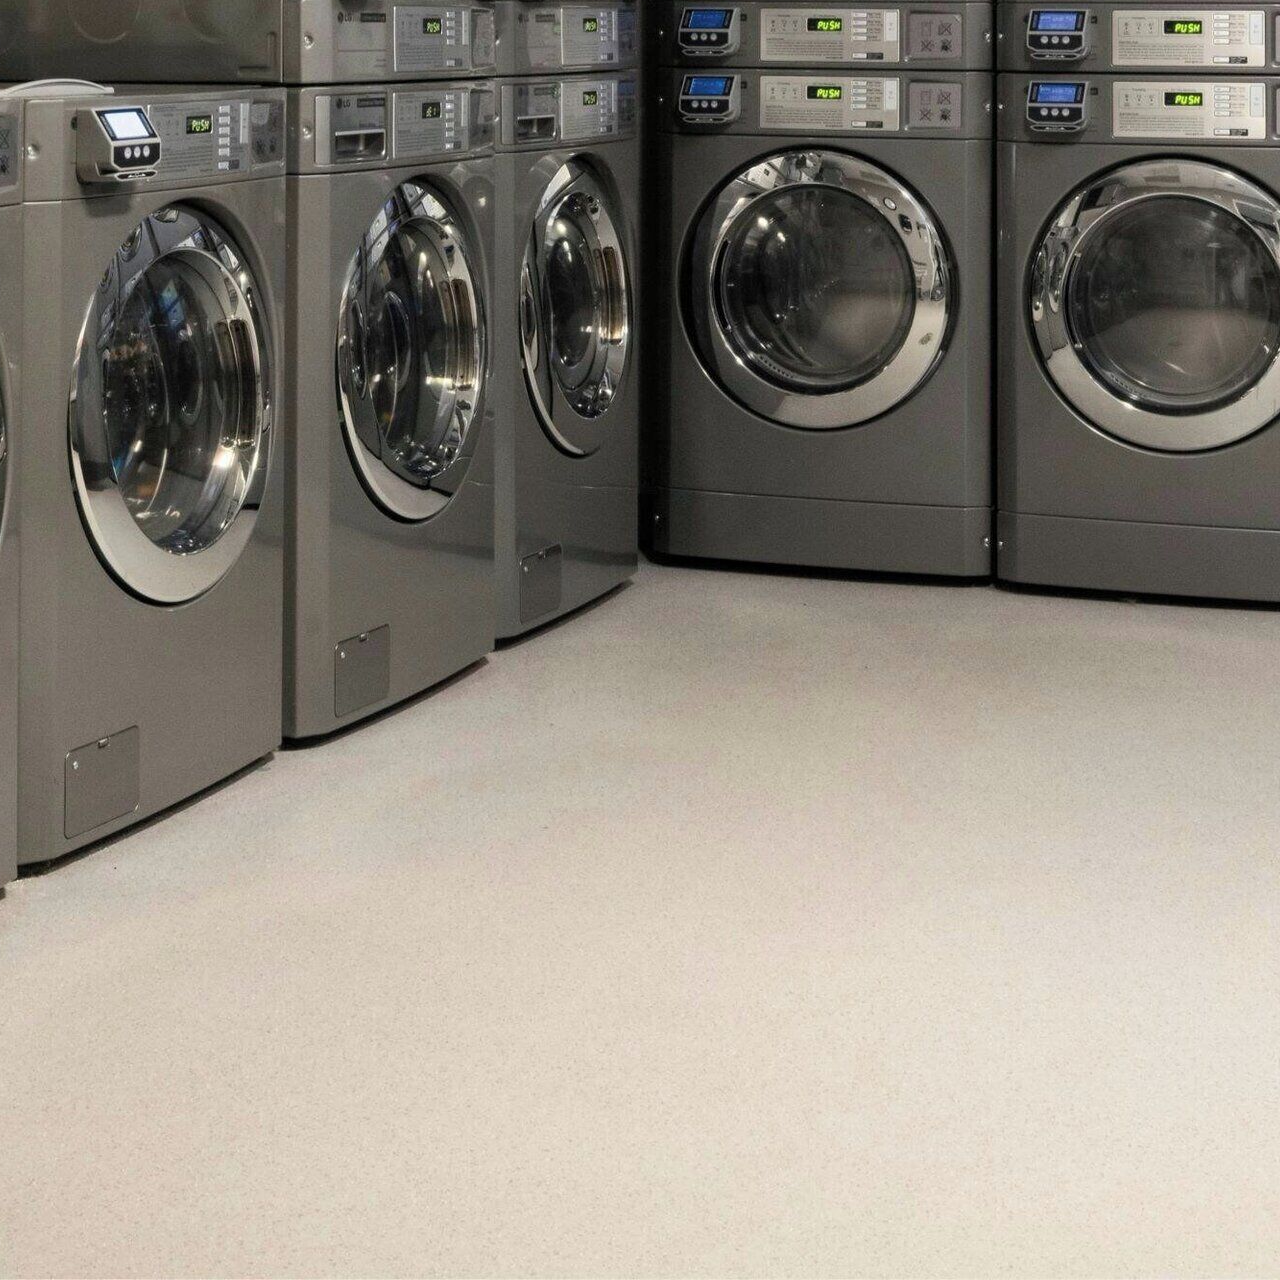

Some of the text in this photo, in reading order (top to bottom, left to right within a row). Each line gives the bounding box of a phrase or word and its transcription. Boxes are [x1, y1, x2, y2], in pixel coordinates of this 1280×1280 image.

[817, 21, 841, 31] PUSH
[1175, 23, 1201, 34] PUSH
[816, 88, 841, 99] PUSH
[1175, 95, 1201, 106] PUSH
